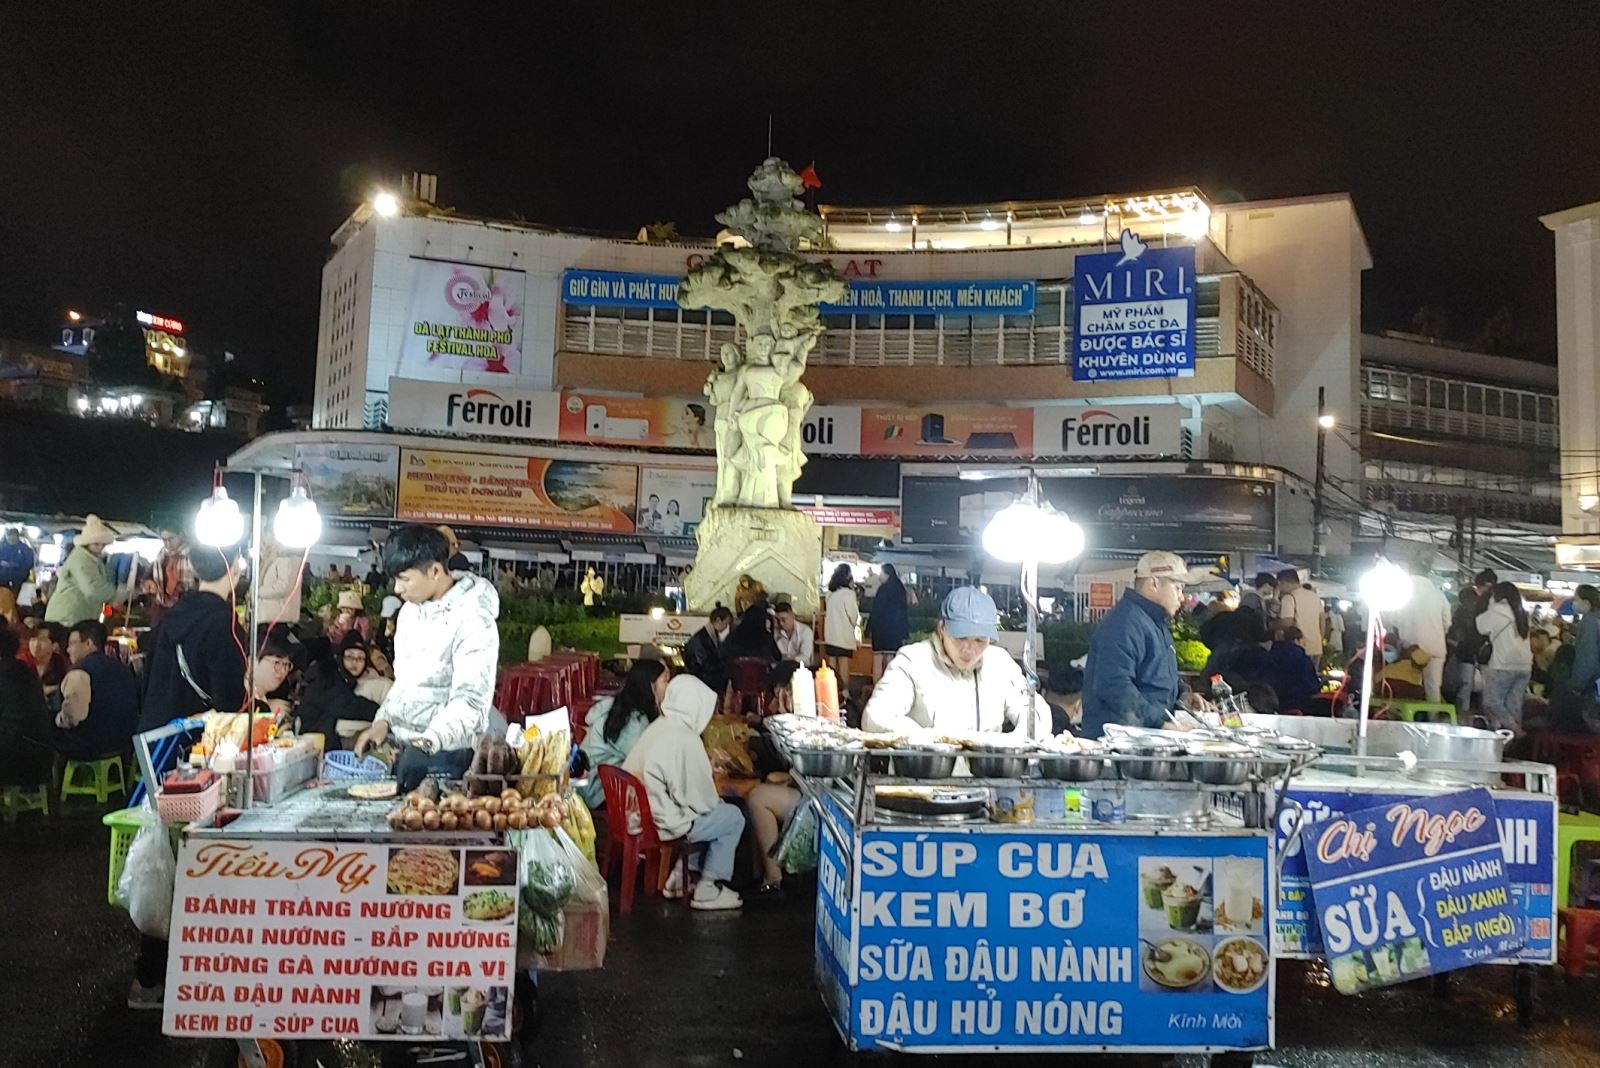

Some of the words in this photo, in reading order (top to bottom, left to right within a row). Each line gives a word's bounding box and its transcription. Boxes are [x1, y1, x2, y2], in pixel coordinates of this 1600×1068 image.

[570, 276, 589, 297] GIỮ
[591, 276, 609, 298] GÌN
[612, 277, 626, 299] VÀ
[629, 279, 656, 300] PHÁT
[659, 283, 680, 301] HUY
[889, 289, 924, 307] THANH
[927, 289, 954, 310] LỊCH,
[1103, 307, 1122, 320] MỸ
[1125, 303, 1164, 318] PHẨM
[1160, 318, 1180, 329] DA
[414, 320, 430, 336] ĐÀ
[432, 323, 452, 339] LẠT
[453, 325, 489, 342] THÀNH
[490, 325, 513, 344] PHỐ
[1080, 335, 1127, 353] ĐƯỢC
[1131, 331, 1166, 349] BÁC
[1170, 330, 1187, 347] SĨ
[427, 340, 475, 356] FESTIVAL
[476, 344, 499, 359] HOA
[1079, 352, 1138, 368] KHUYÊN
[1142, 350, 1187, 366] DÙNG
[447, 393, 532, 428] Ferroli
[1062, 416, 1150, 451] Ferroli
[1317, 820, 1378, 864] Chị
[1385, 804, 1487, 857] Ngọc
[186, 843, 288, 878] Tiểu
[861, 833, 978, 879] SÚP
[997, 841, 1109, 880] CUA
[1428, 865, 1461, 895] ĐẬU
[1462, 858, 1503, 884] NÀNH
[184, 893, 257, 915] BÁNH
[360, 898, 451, 920] NƯỚNG
[860, 890, 988, 929] KEM
[1009, 888, 1087, 929] BƠ
[1436, 892, 1468, 920] ĐẬU
[1469, 885, 1508, 912] XANH
[1324, 883, 1416, 954] SỮA
[1475, 911, 1516, 942] (NGÔ)
[181, 926, 254, 945] KHOAI
[261, 925, 346, 947] NƯỚNG
[427, 928, 511, 949] NƯỚNG
[179, 952, 269, 974] TRỨNG
[278, 954, 314, 975] GÀ
[323, 955, 418, 978] NƯỚNG
[427, 960, 472, 978] GIA
[482, 960, 506, 980] VỊ
[860, 938, 934, 982] SỮA
[945, 938, 1019, 990] ĐẬU
[1031, 938, 1132, 983] NÀNH
[177, 981, 226, 1003] SỮA
[234, 983, 283, 1008] ĐẬU
[291, 984, 361, 1005] NÀNH
[174, 1013, 219, 1032] KEM
[225, 1013, 254, 1033] BƠ
[273, 1012, 314, 1033] SÚP
[321, 1016, 360, 1034] CUA
[859, 991, 938, 1044] ĐẬU
[951, 988, 1002, 1036] HỦ
[1015, 992, 1123, 1036] NÓNG
